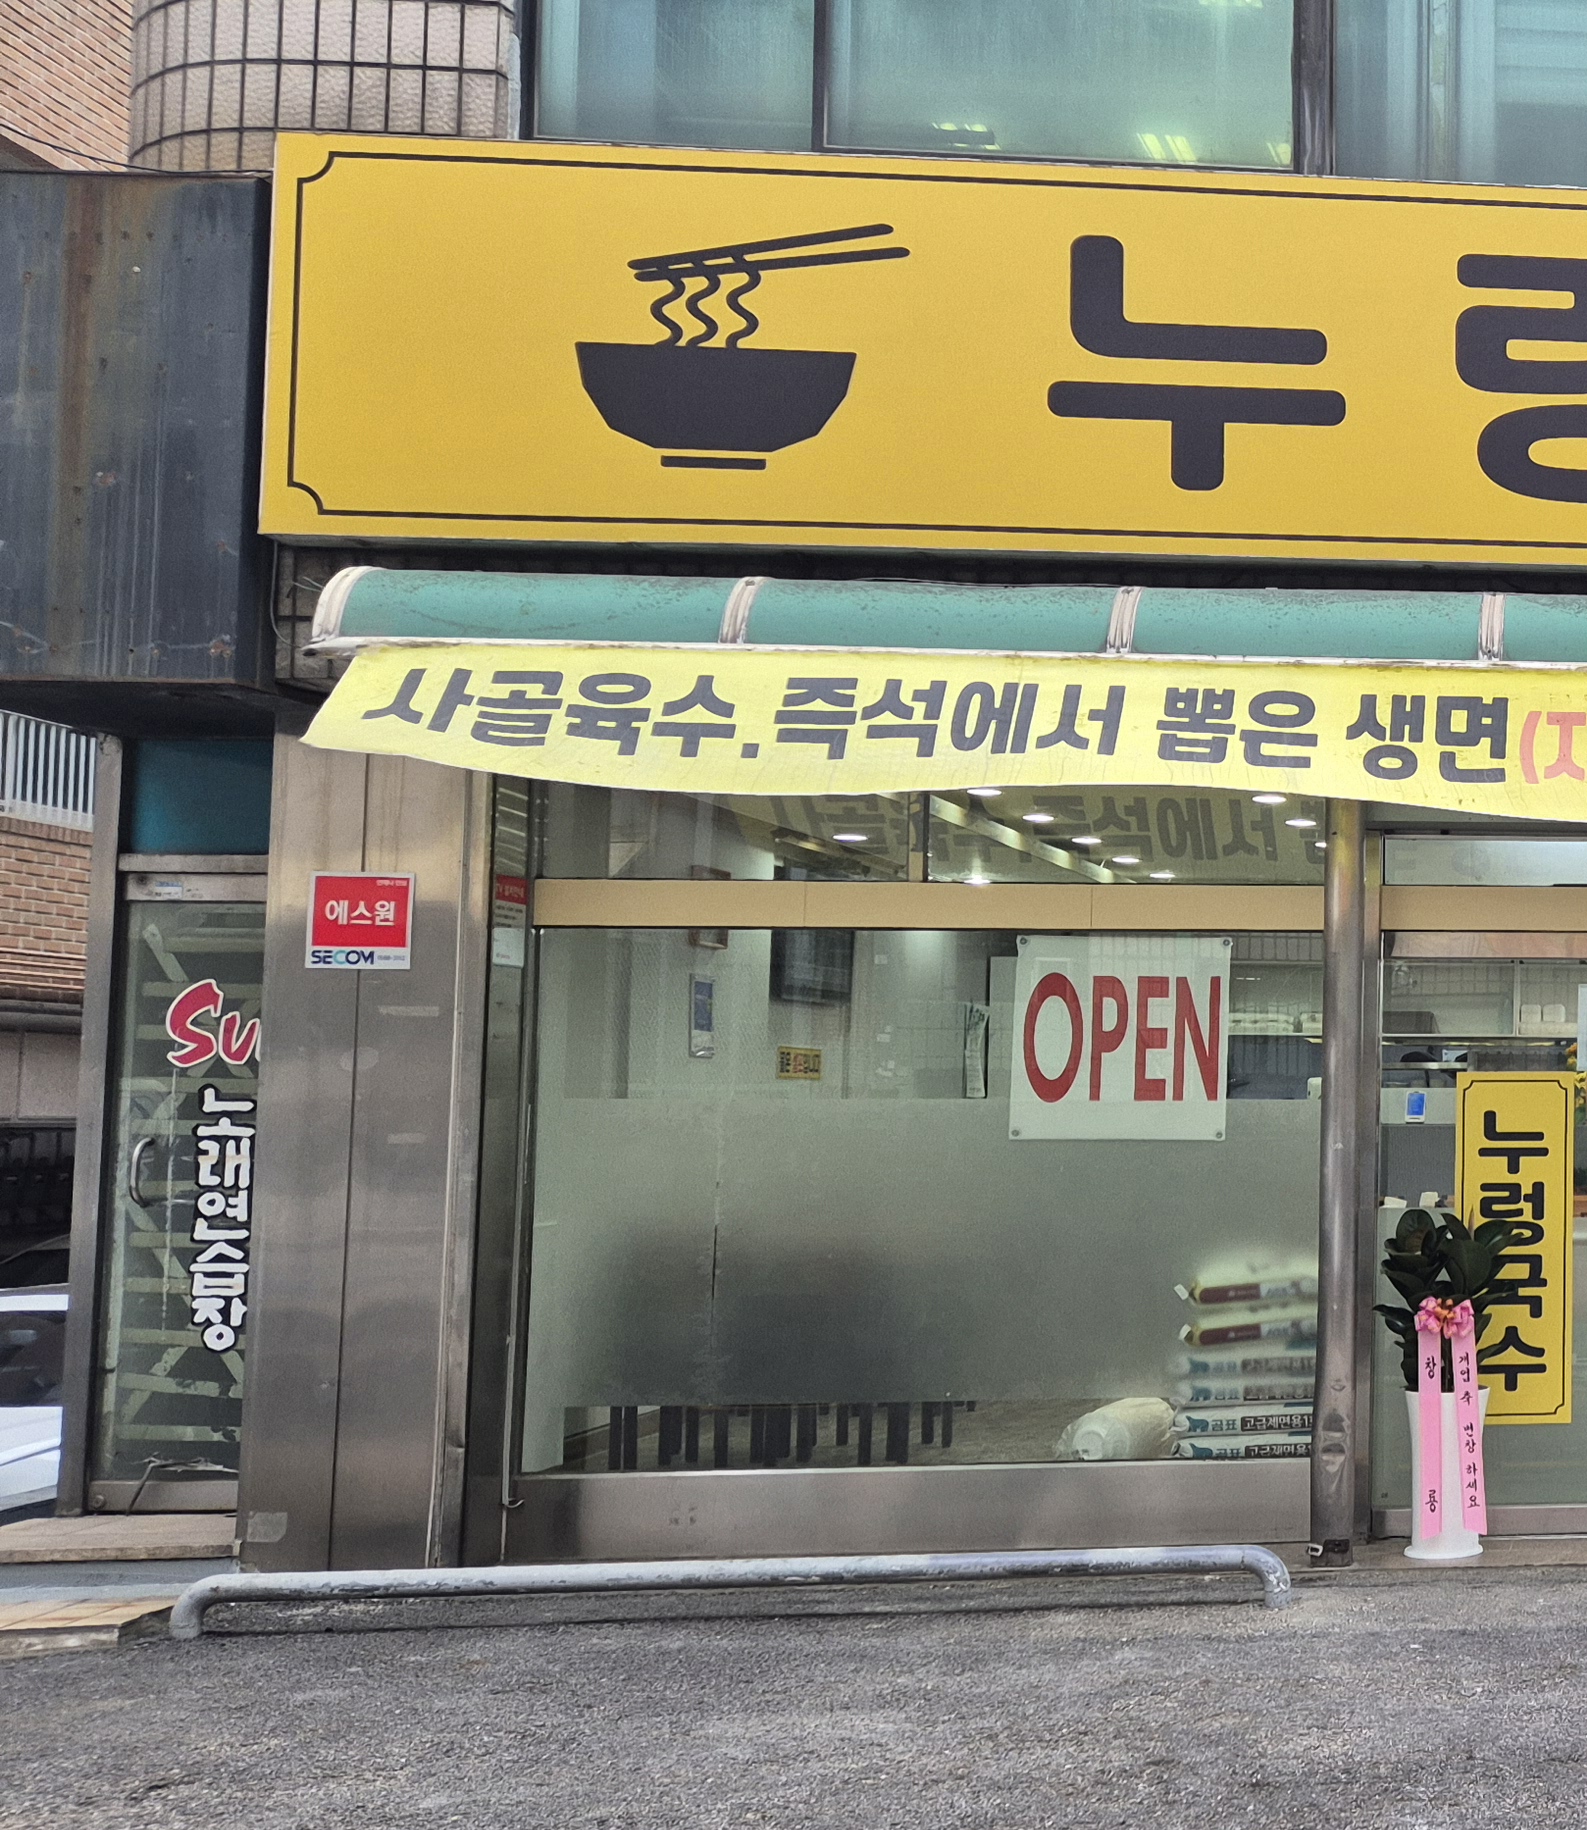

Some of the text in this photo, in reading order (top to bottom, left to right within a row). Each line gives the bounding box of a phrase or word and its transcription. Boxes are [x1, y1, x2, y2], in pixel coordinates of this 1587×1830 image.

[1157, 687, 1317, 768] 뽑은
[311, 950, 375, 965] SECOM
[325, 900, 396, 926] 에스원
[1023, 971, 1222, 1104] OPEN
[189, 1086, 256, 1352] 노래연습장
[1477, 1110, 1550, 1391] 누렁국수
